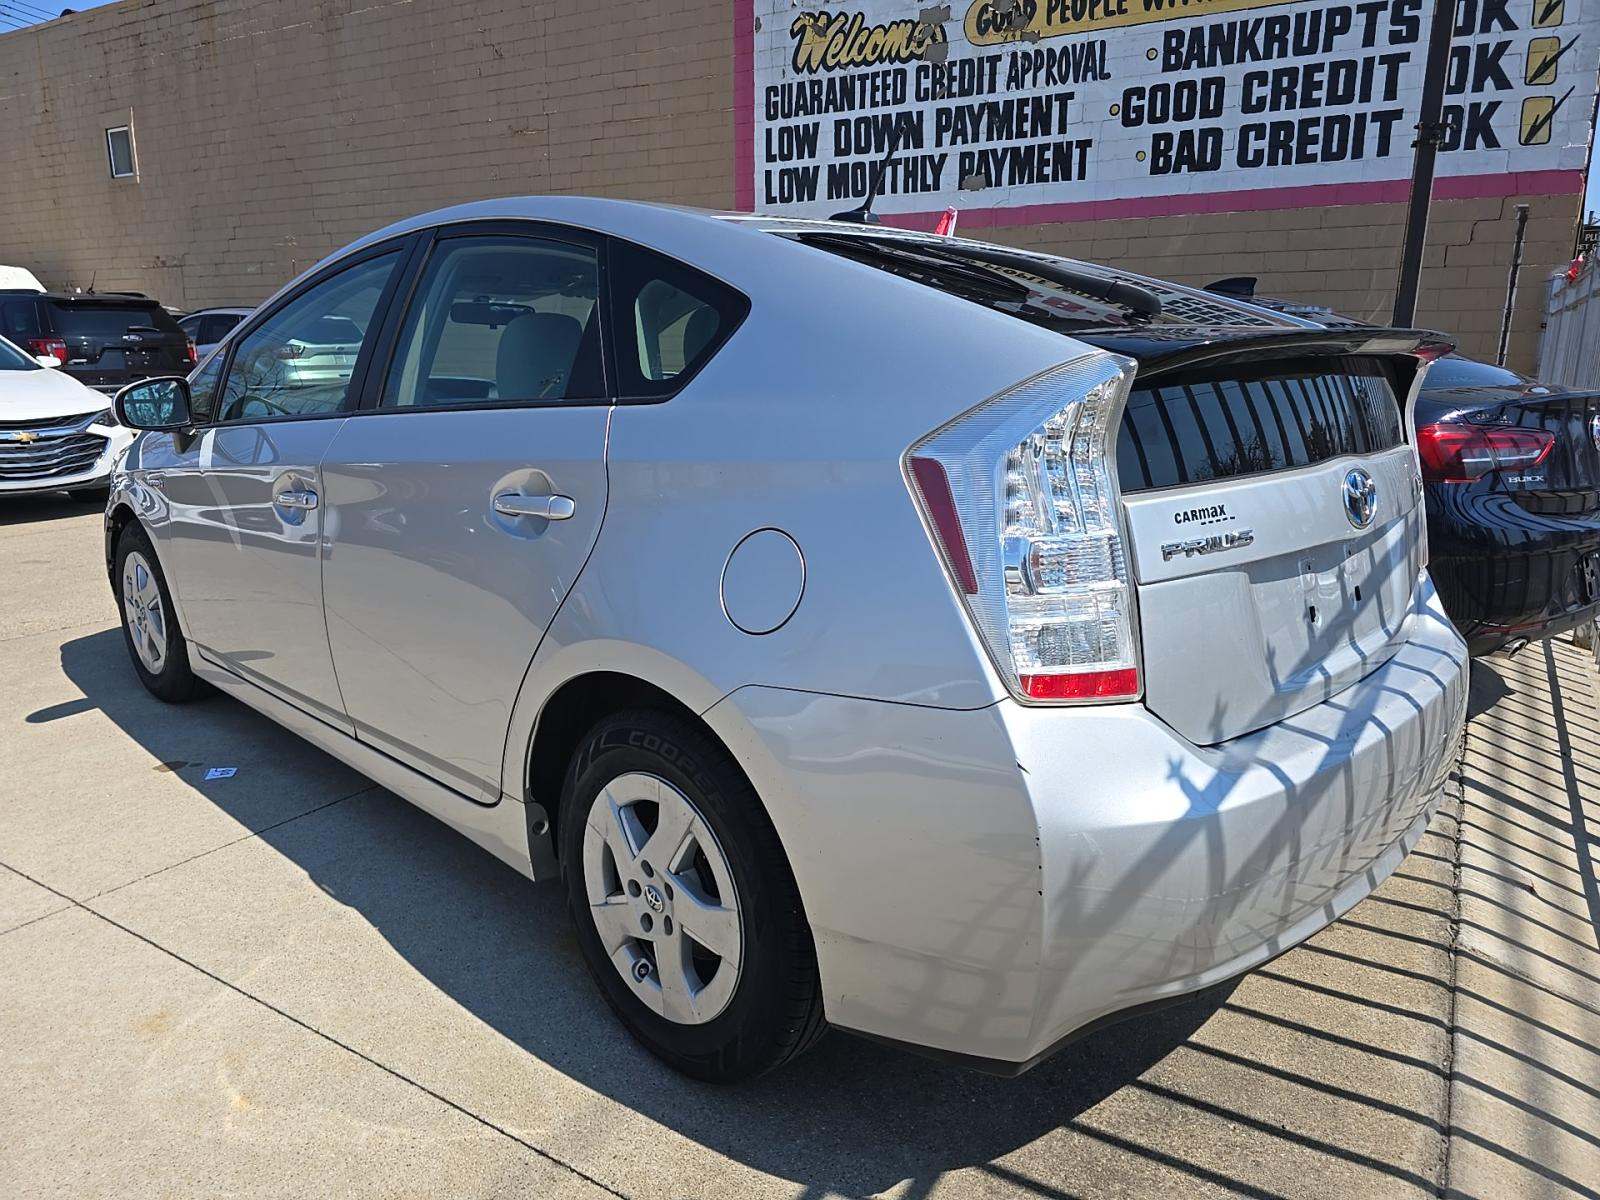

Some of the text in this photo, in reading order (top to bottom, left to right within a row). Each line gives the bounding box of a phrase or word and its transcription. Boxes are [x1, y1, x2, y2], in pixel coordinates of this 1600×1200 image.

[1162, 0, 1422, 73] BANKRUPTS
[766, 39, 1112, 121] GUARANTEED CREDIT APPROVAL
[1121, 77, 1225, 127] GOOD
[1241, 52, 1410, 114] CREDIT
[765, 92, 1075, 163] LOW DOWN PAYMENT
[1150, 127, 1223, 175] BAD
[1237, 109, 1403, 168] CREDIT
[765, 139, 1093, 205] LOW MONTHLY PAYMENT
[1160, 529, 1255, 562] PRIUS
